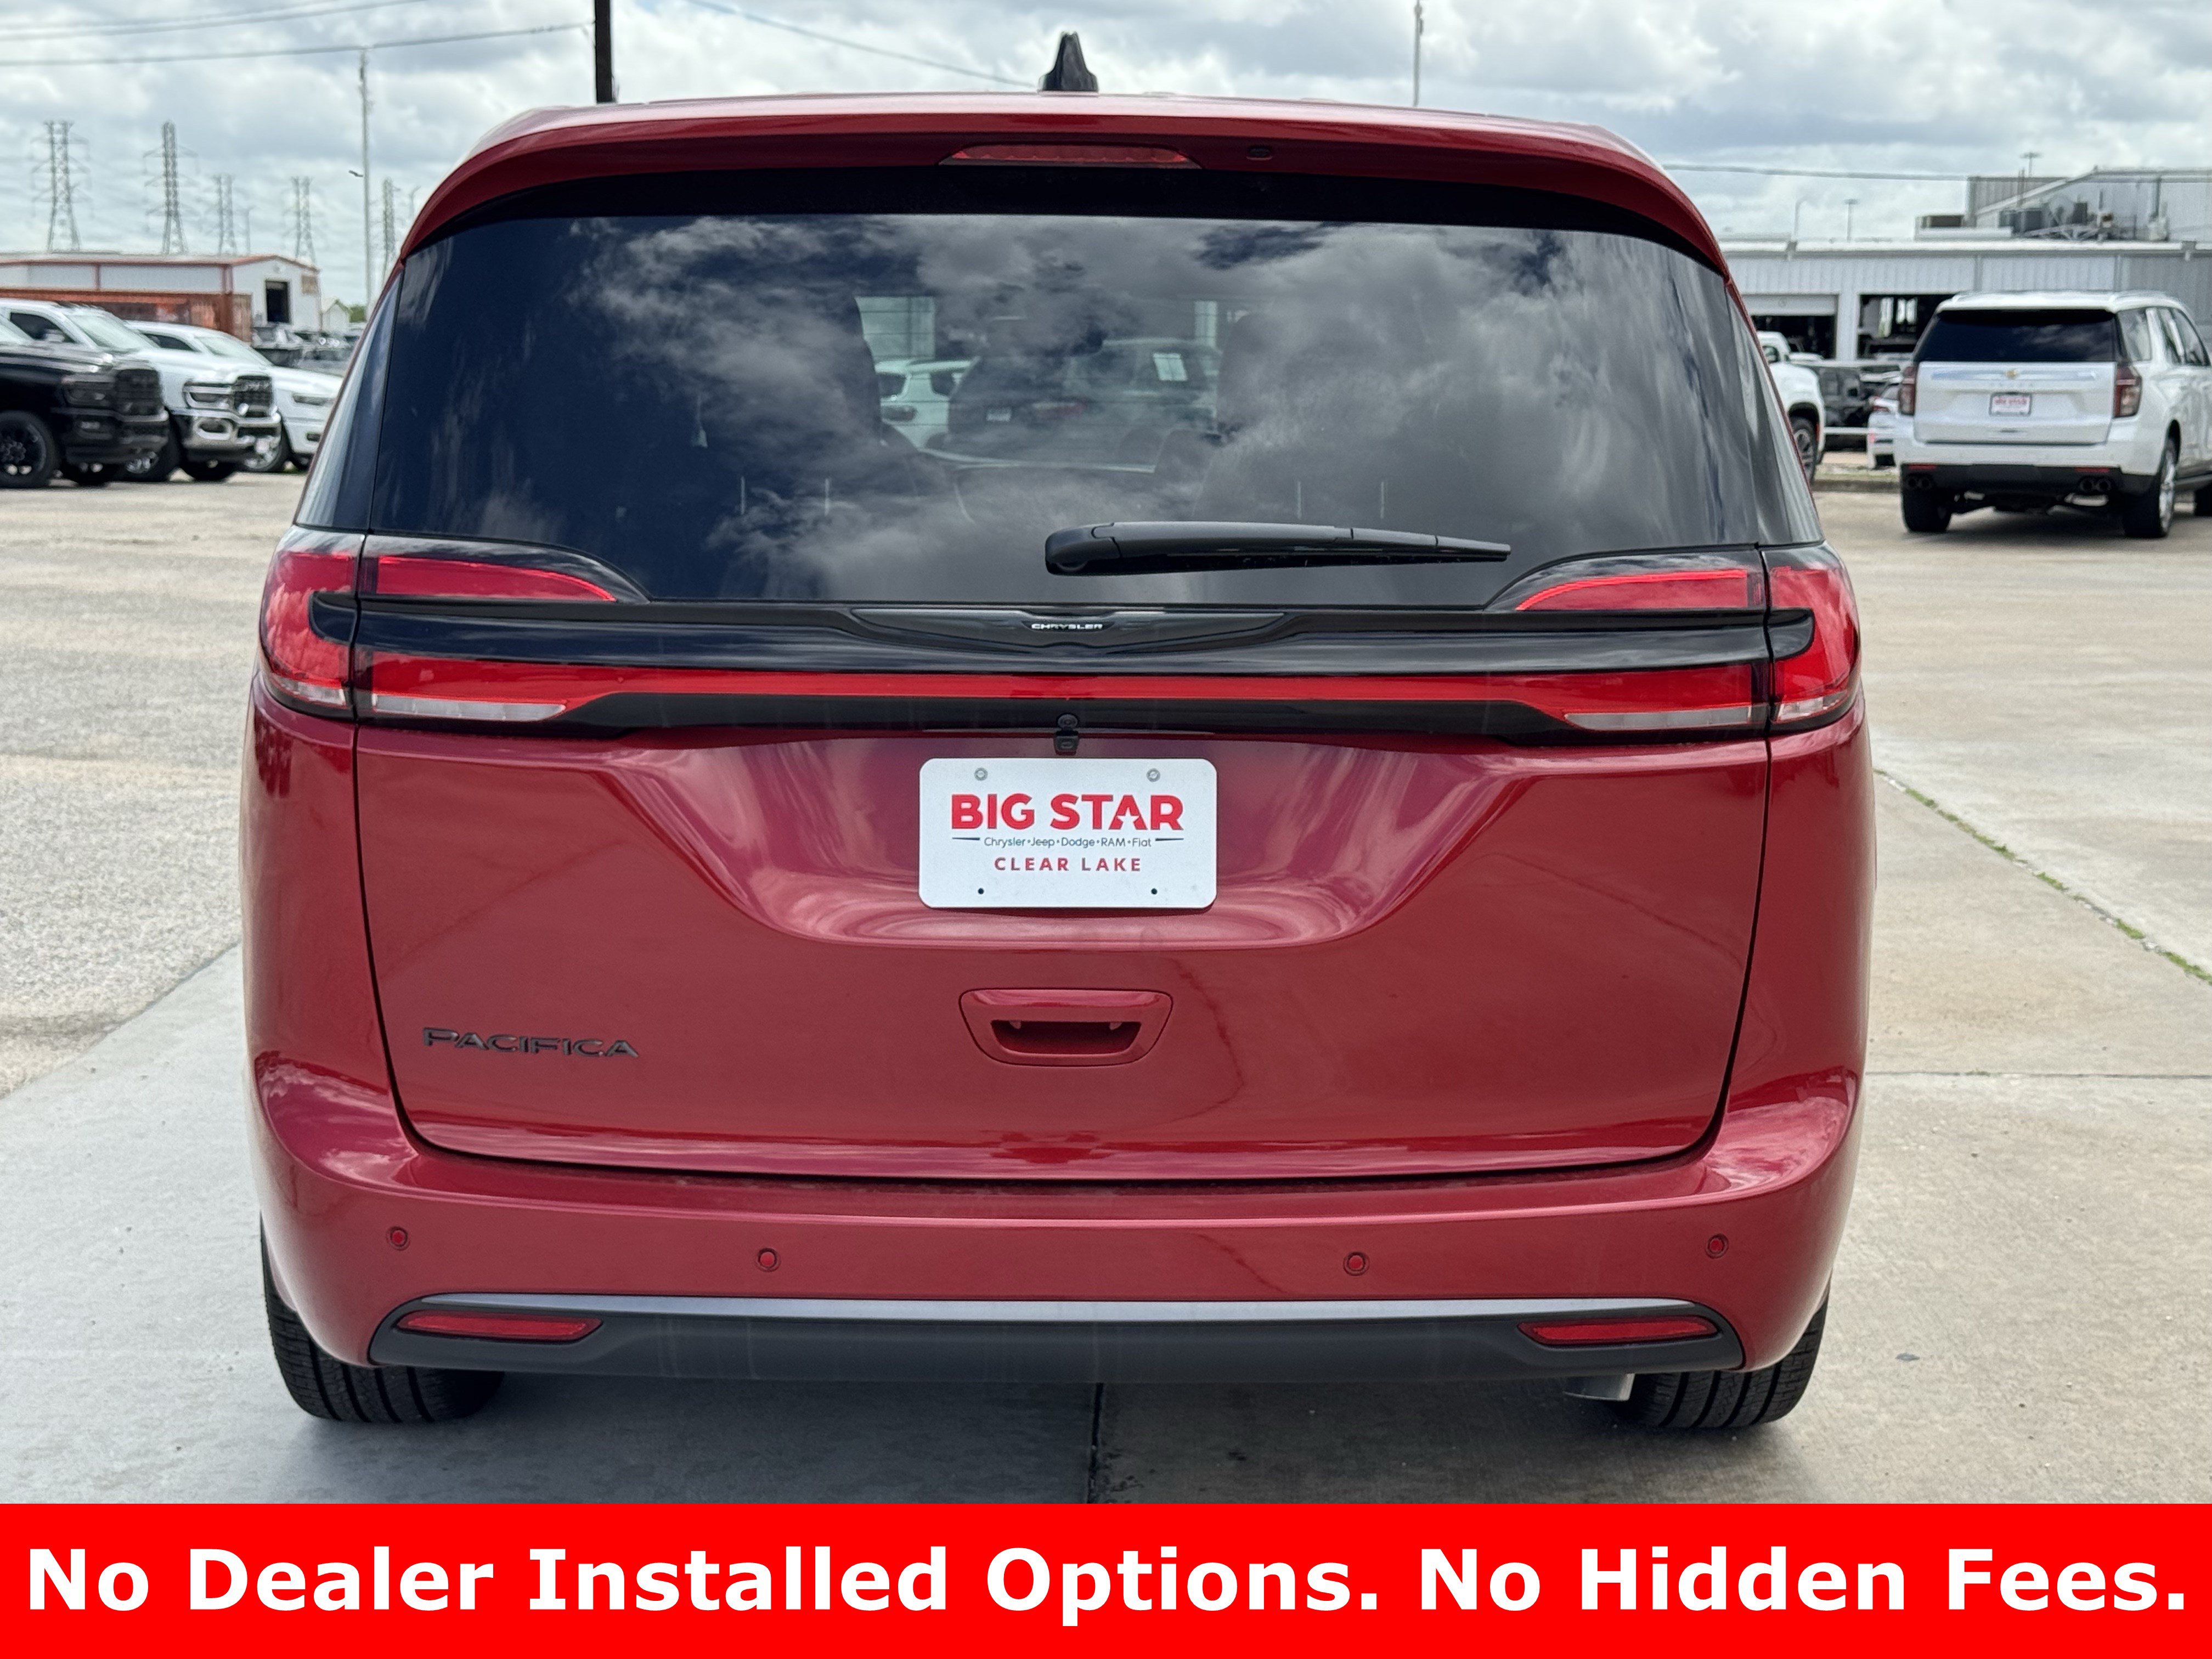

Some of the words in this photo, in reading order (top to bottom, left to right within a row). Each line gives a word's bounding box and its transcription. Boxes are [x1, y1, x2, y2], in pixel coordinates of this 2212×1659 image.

[951, 792, 1035, 830] BIG
[1050, 793, 1184, 831] STAR
[994, 857, 1069, 871] CLEAR
[1081, 857, 1142, 872] LAKE
[423, 1027, 639, 1058] PACIFICA
